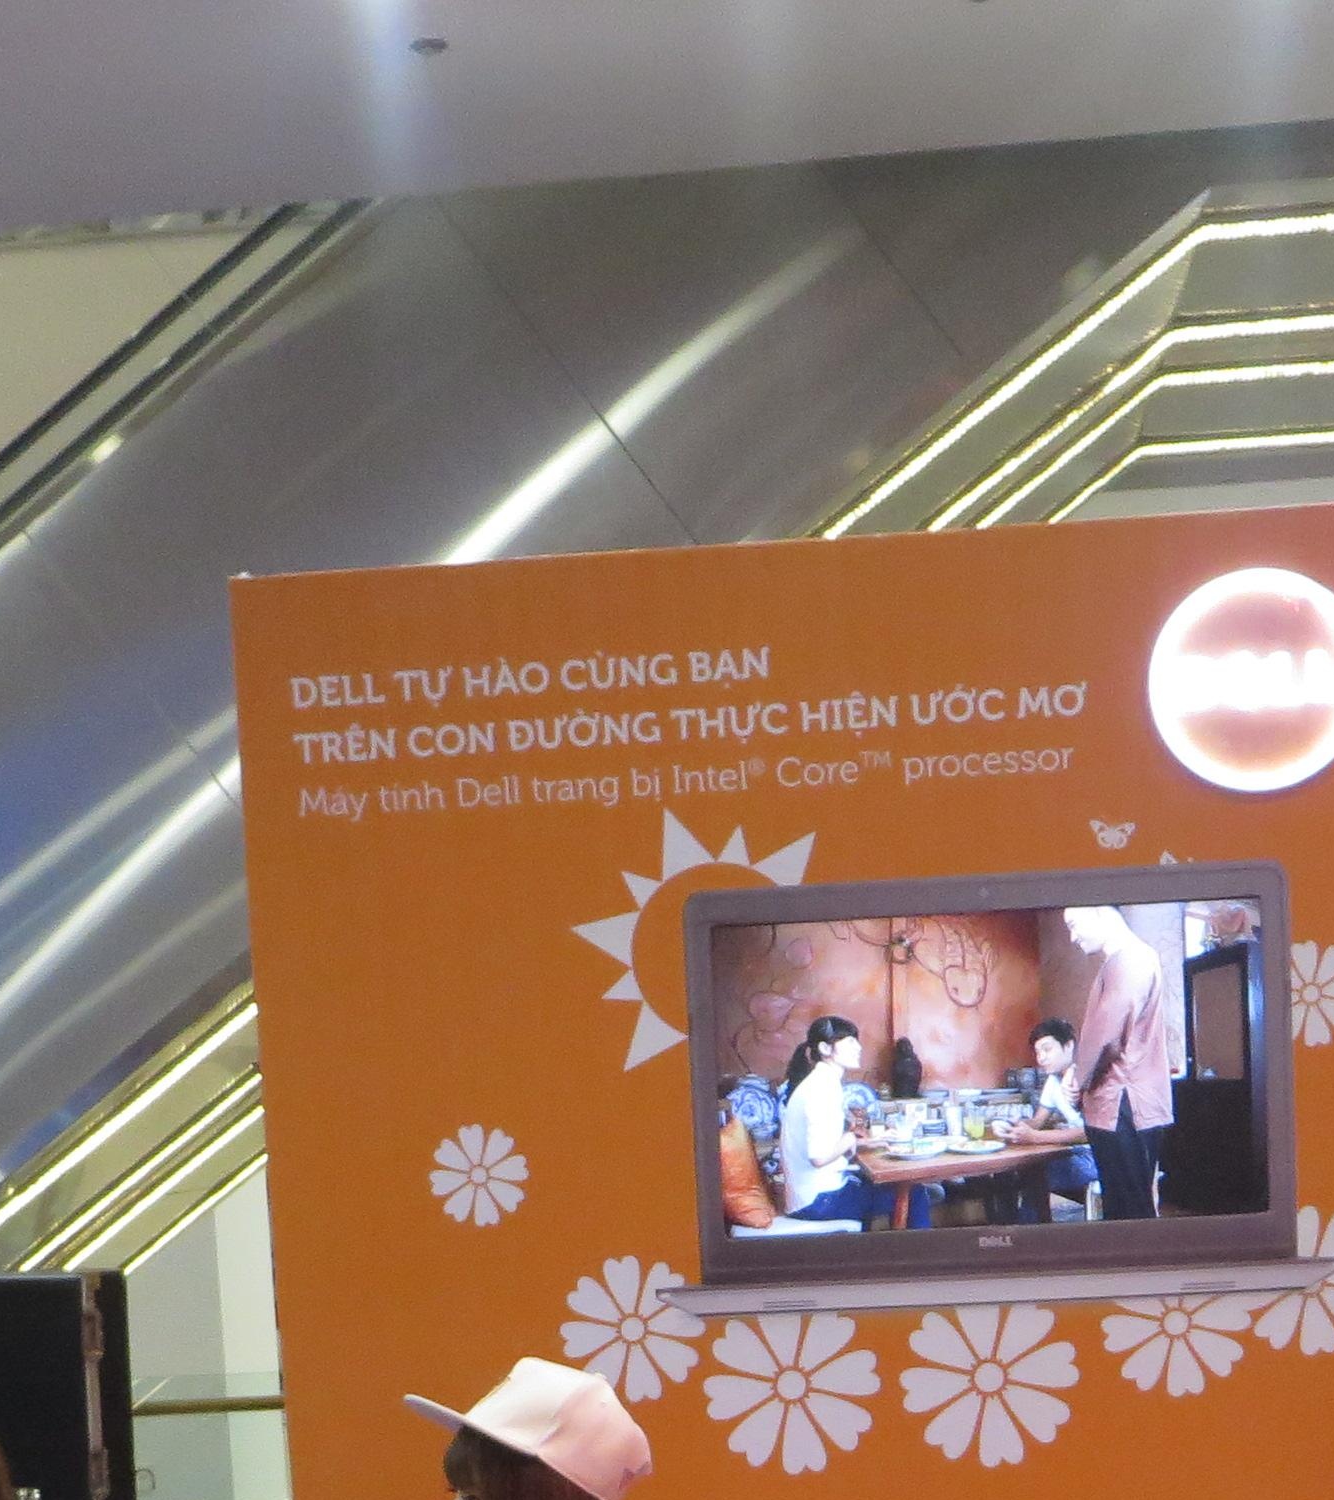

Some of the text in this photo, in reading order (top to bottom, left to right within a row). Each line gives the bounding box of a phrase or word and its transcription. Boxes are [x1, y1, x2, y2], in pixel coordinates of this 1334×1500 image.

[289, 646, 770, 709] DELL TỰ HÀO CÙNG BẠN
[293, 680, 1087, 764] TRÊN CON ĐƯỜNG THỰC HIỆN ƯỚC MƠ
[299, 786, 369, 822] Máy
[379, 780, 446, 813] tính
[456, 775, 522, 808] Dell
[530, 774, 621, 808] trang
[630, 767, 662, 802] bị
[902, 746, 1075, 785] processor
[978, 1235, 1014, 1249] DELL
